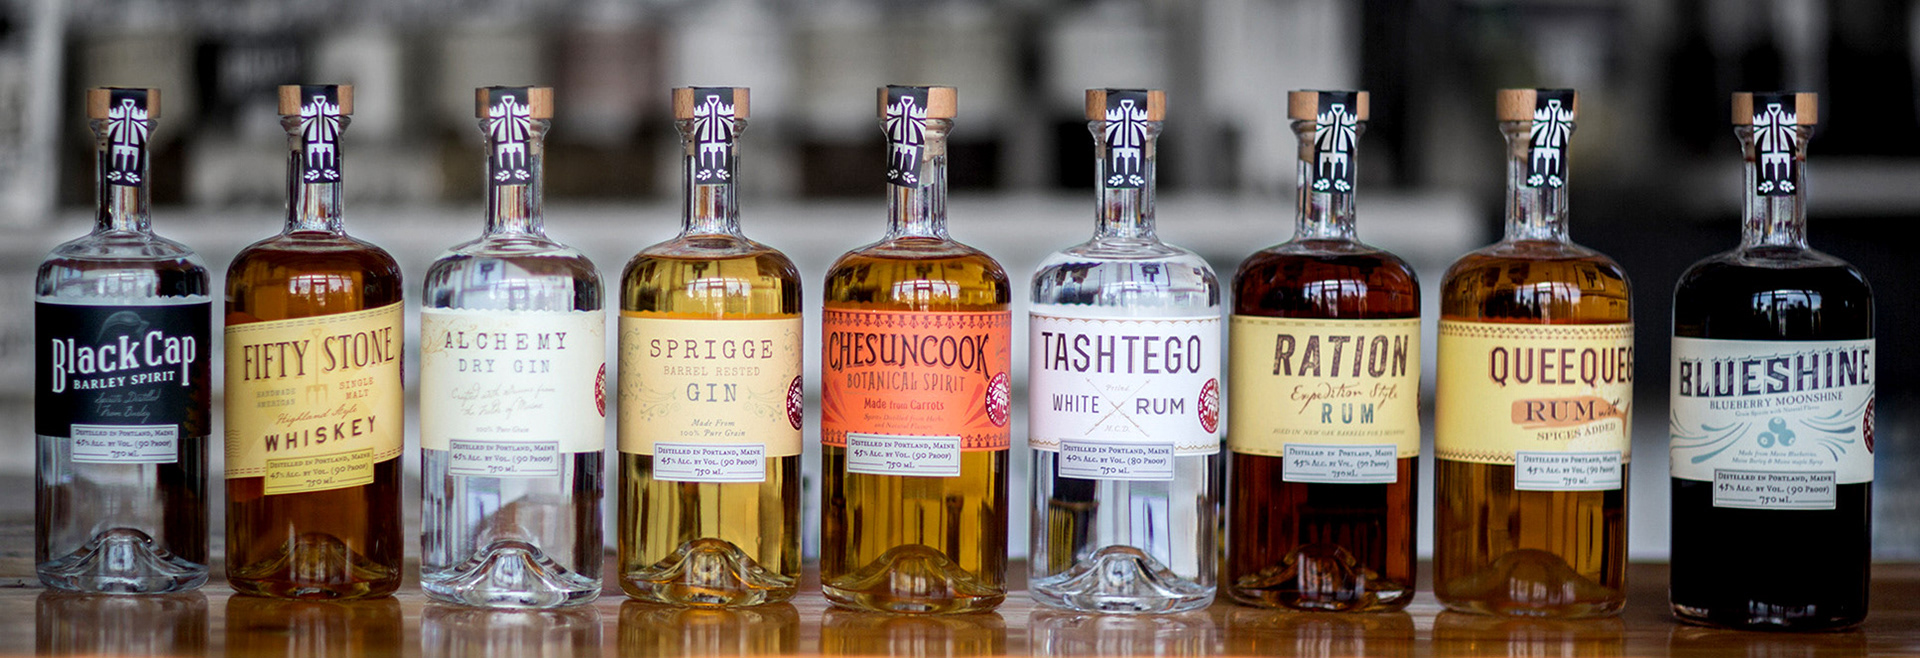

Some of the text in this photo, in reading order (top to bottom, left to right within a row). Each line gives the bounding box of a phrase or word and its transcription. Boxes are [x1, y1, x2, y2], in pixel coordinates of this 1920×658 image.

[444, 332, 567, 350] ALCHEMY
[650, 339, 773, 359] SPRIGGE
[52, 331, 196, 393] Black Cap
[244, 327, 394, 381] FIFTY STONE
[829, 332, 990, 379] CHESUNCOOK
[1042, 332, 1200, 374] TASHTEGO
[1273, 334, 1409, 377] RATION
[459, 359, 550, 373] DRY GIN
[664, 366, 760, 376] BARREL RESTED
[1491, 347, 1632, 387] QUEEQUEG
[1680, 347, 1870, 397] BLUESHINE
[74, 371, 175, 389] BARLEY SPIRIT
[340, 377, 373, 389] SINGLE
[847, 371, 965, 393] BOTANICAL SPIRIT
[256, 388, 296, 397] HANDMADE
[346, 389, 369, 399] MALT
[687, 383, 737, 402] GIN
[1291, 382, 1398, 415] Expedition Style
[1710, 391, 1843, 410] BLUEBERRY MOONSHINE
[257, 399, 295, 408] AMERICAN
[864, 398, 944, 410] Made from Carrots
[1053, 394, 1184, 414] WHITE RUM
[1322, 403, 1373, 424] RUM
[1525, 401, 1595, 421] RUM
[276, 404, 357, 427] Highland Style
[715, 419, 735, 427] From
[265, 416, 376, 452] WHISKEY
[1537, 423, 1615, 441] SPICES ADDED
